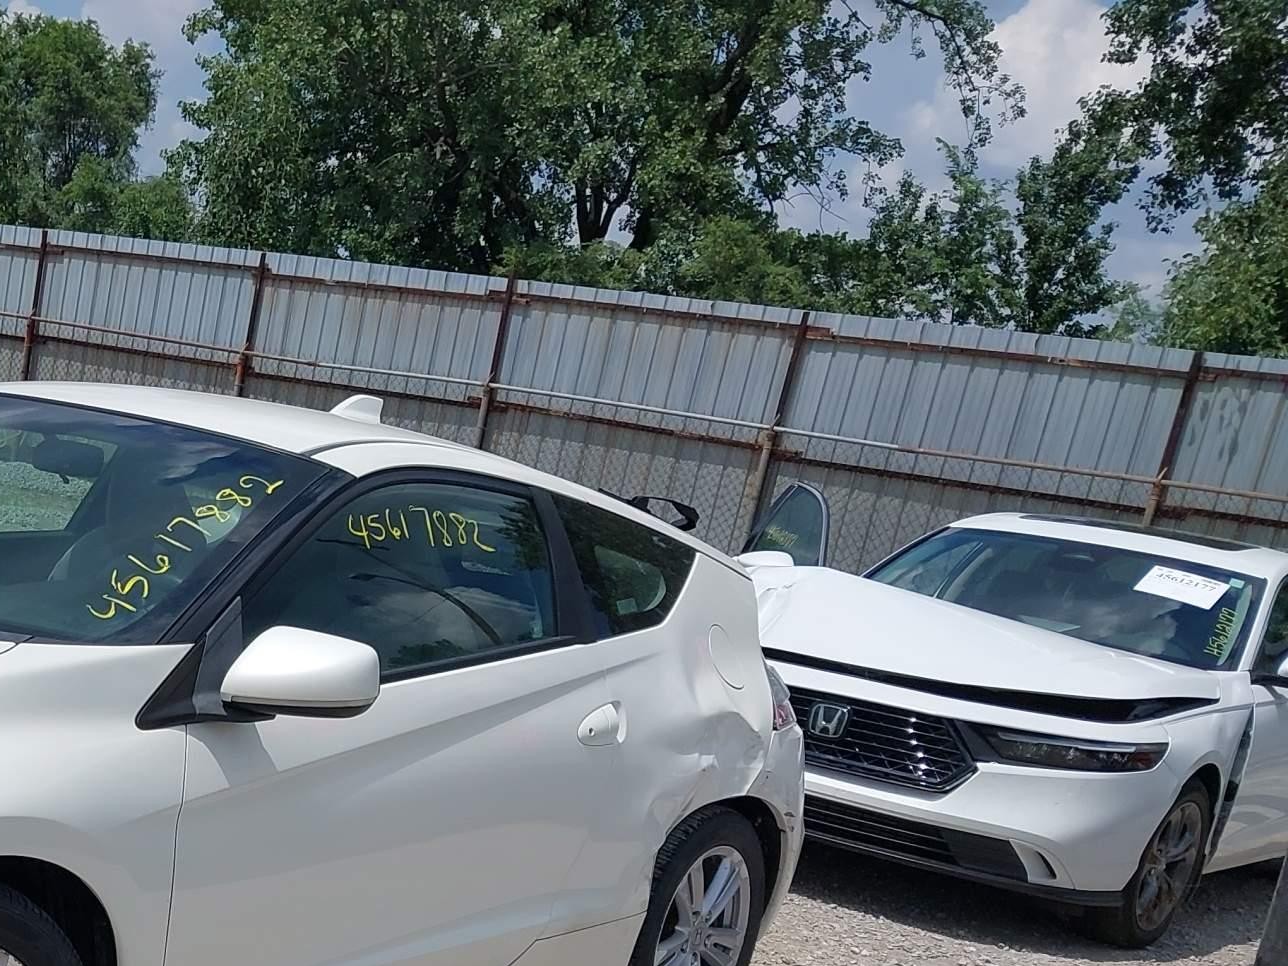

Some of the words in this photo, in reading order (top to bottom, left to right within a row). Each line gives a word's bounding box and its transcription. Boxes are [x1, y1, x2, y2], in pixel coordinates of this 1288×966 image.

[86, 473, 285, 620] 45617882
[347, 504, 497, 553] 45617882
[1155, 573, 1217, 592] 45612177
